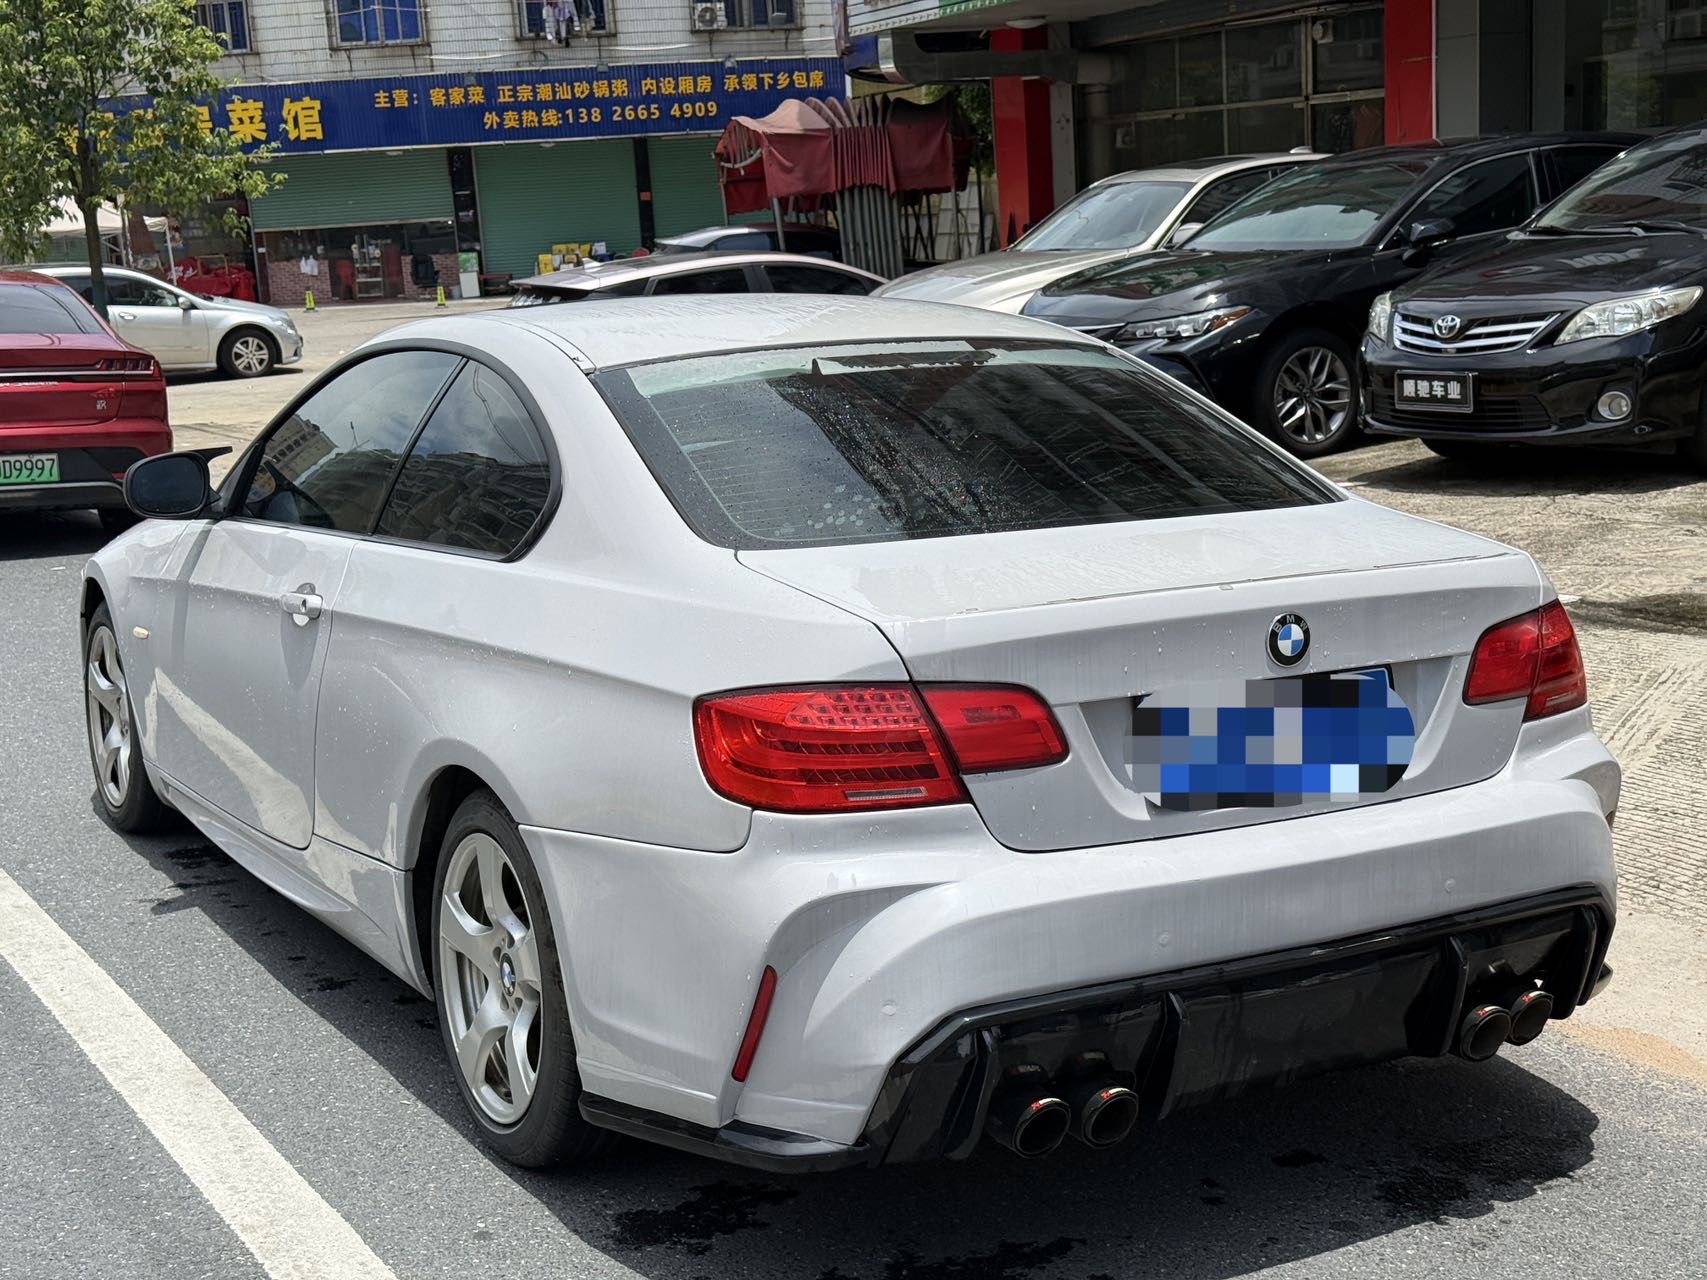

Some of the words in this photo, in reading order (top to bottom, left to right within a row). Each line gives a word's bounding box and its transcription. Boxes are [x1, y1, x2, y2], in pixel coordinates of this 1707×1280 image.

[374, 90, 419, 108] 主营：
[430, 86, 485, 106] 客家菜
[497, 79, 628, 103] 正宗潮汕砂锅粥
[641, 75, 713, 95] 内设厢房
[724, 70, 824, 92] 承领下乡包席
[612, 105, 660, 121] 2665
[671, 101, 718, 118] 4909
[0, 458, 56, 479] D9997
[1272, 614, 1308, 633] BMW
